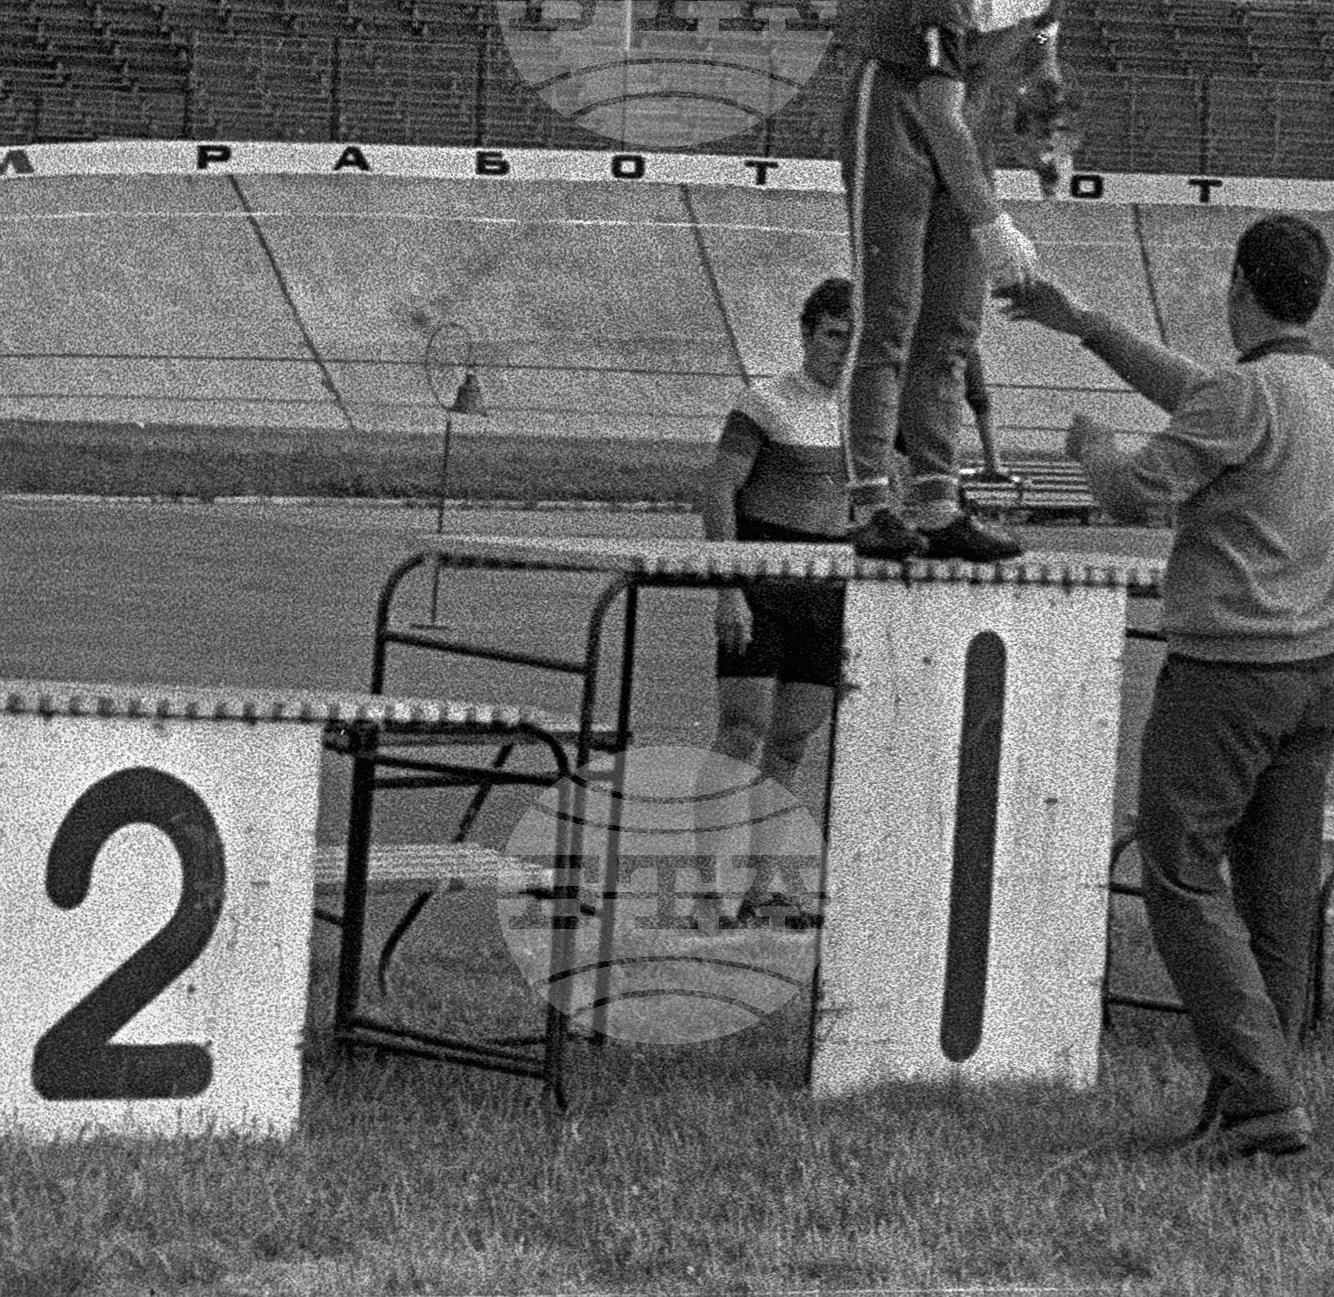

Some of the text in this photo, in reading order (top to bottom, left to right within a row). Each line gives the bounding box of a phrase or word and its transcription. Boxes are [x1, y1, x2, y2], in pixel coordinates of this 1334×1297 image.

[196, 145, 779, 186] РАБОТ
[1069, 173, 1224, 203] ОТ
[31, 766, 227, 1102] 2
